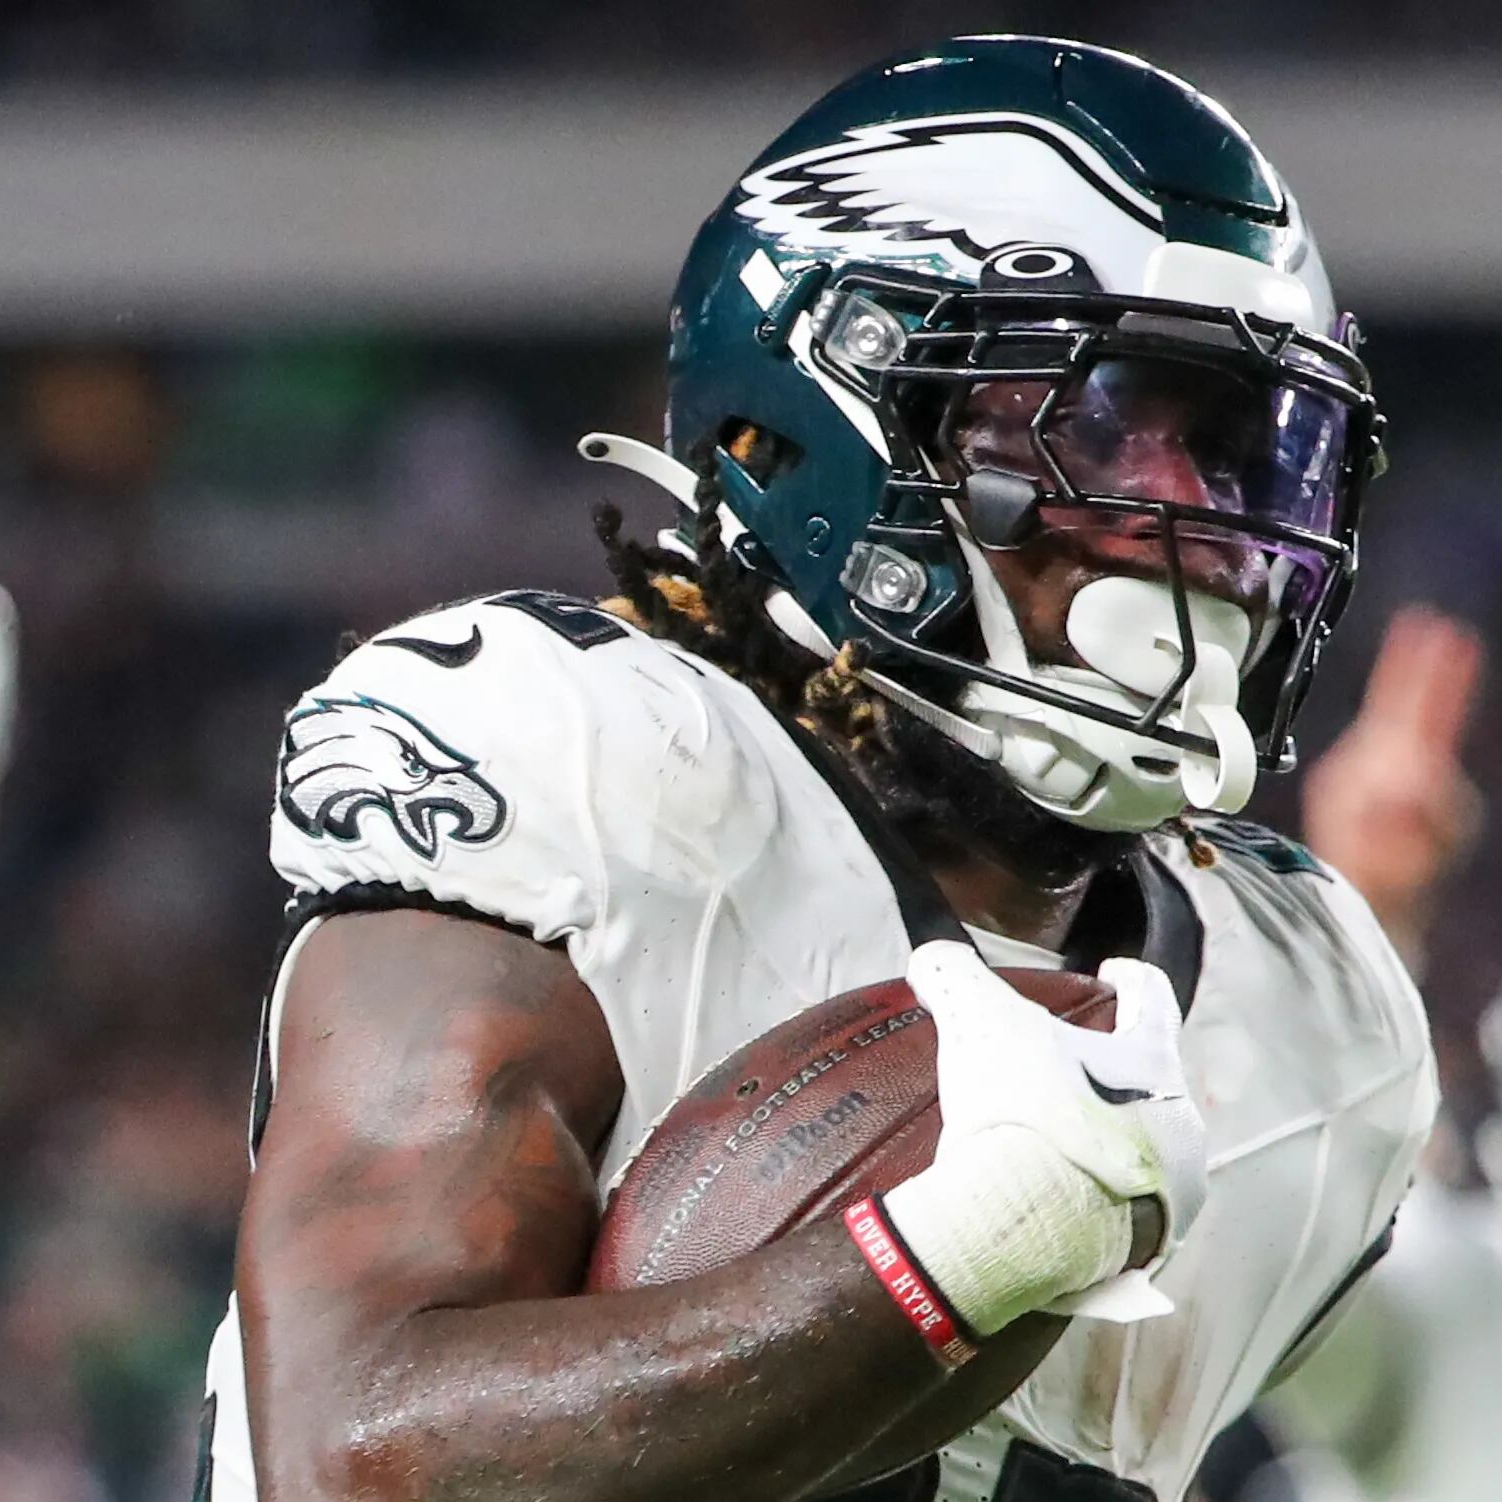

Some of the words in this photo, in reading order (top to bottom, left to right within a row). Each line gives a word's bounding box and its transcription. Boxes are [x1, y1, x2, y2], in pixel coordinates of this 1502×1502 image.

[635, 1162, 725, 1285] NATIONAL
[725, 1049, 850, 1152] FOOTBALL
[851, 1007, 926, 1047] LEAG
[854, 1216, 898, 1272] OVER
[890, 1271, 943, 1331] HYPE
